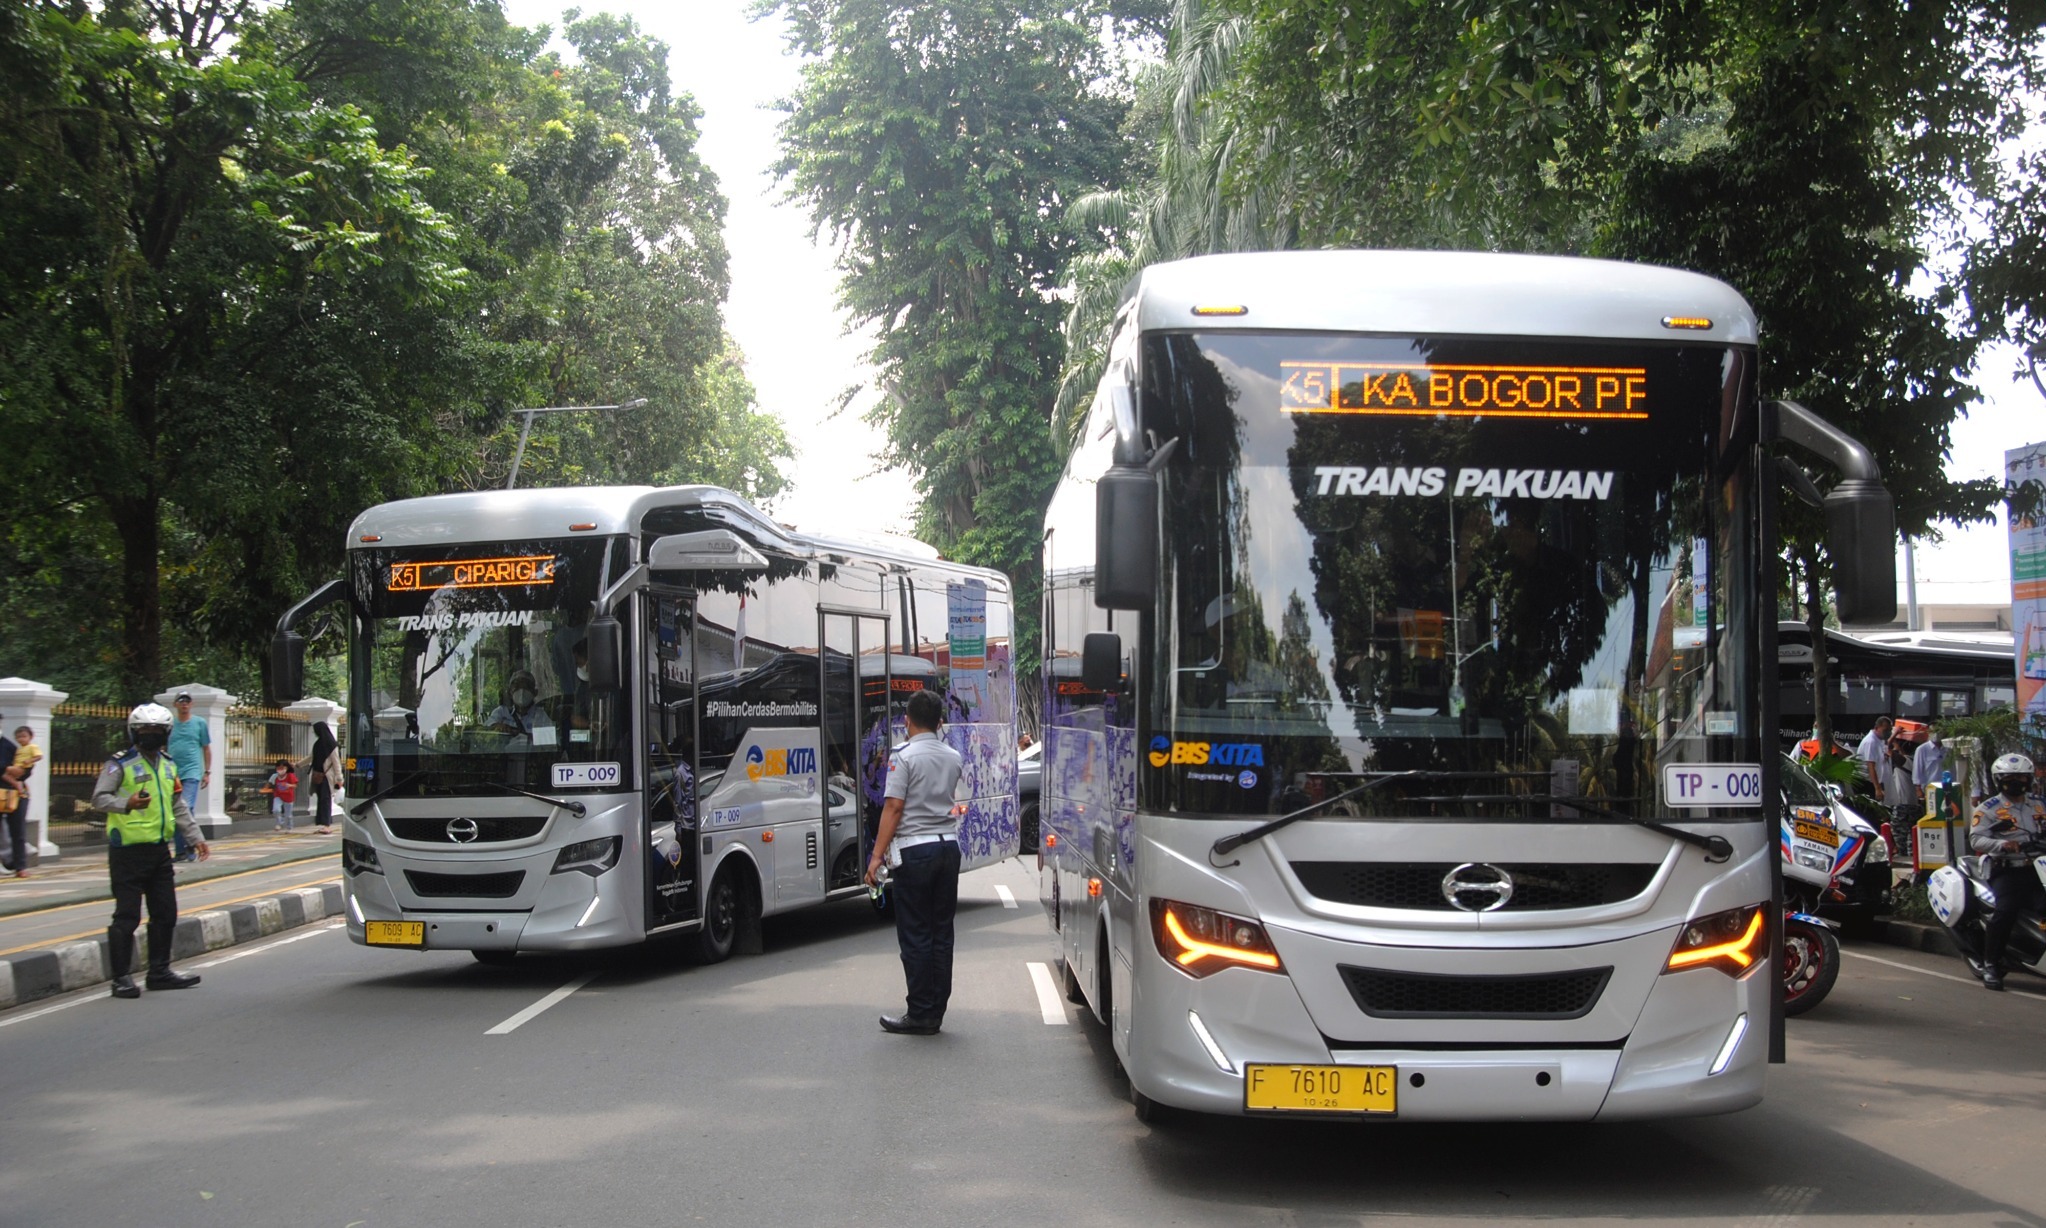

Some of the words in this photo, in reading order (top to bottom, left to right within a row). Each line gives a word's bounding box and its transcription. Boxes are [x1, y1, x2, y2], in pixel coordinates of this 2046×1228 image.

[1364, 372, 1418, 406] KA
[1430, 373, 1582, 408] BOGOR
[1314, 466, 1447, 496] TRANS
[1454, 468, 1614, 500] PAKUAN
[391, 568, 414, 587] K5
[454, 561, 537, 583] CIPARIGI
[399, 615, 454, 631] TRANS
[457, 610, 534, 629] PAKUAN
[706, 700, 818, 718] #PilihanCerdasBermobilitas
[765, 747, 817, 777] BISKITA
[1171, 741, 1264, 766] BISKITA
[558, 768, 574, 782] TP
[588, 767, 617, 781] 009
[1676, 773, 1703, 798] TP
[1726, 772, 1760, 798] 008
[715, 811, 723, 823] TP
[728, 809, 740, 822] 009
[1803, 840, 1829, 853] YAMAHA
[368, 923, 374, 936] F
[382, 923, 402, 936] 7609
[411, 923, 422, 937] AC
[1253, 1069, 1264, 1092] F
[1290, 1070, 1341, 1094] 7610
[1363, 1071, 1388, 1096] AC
